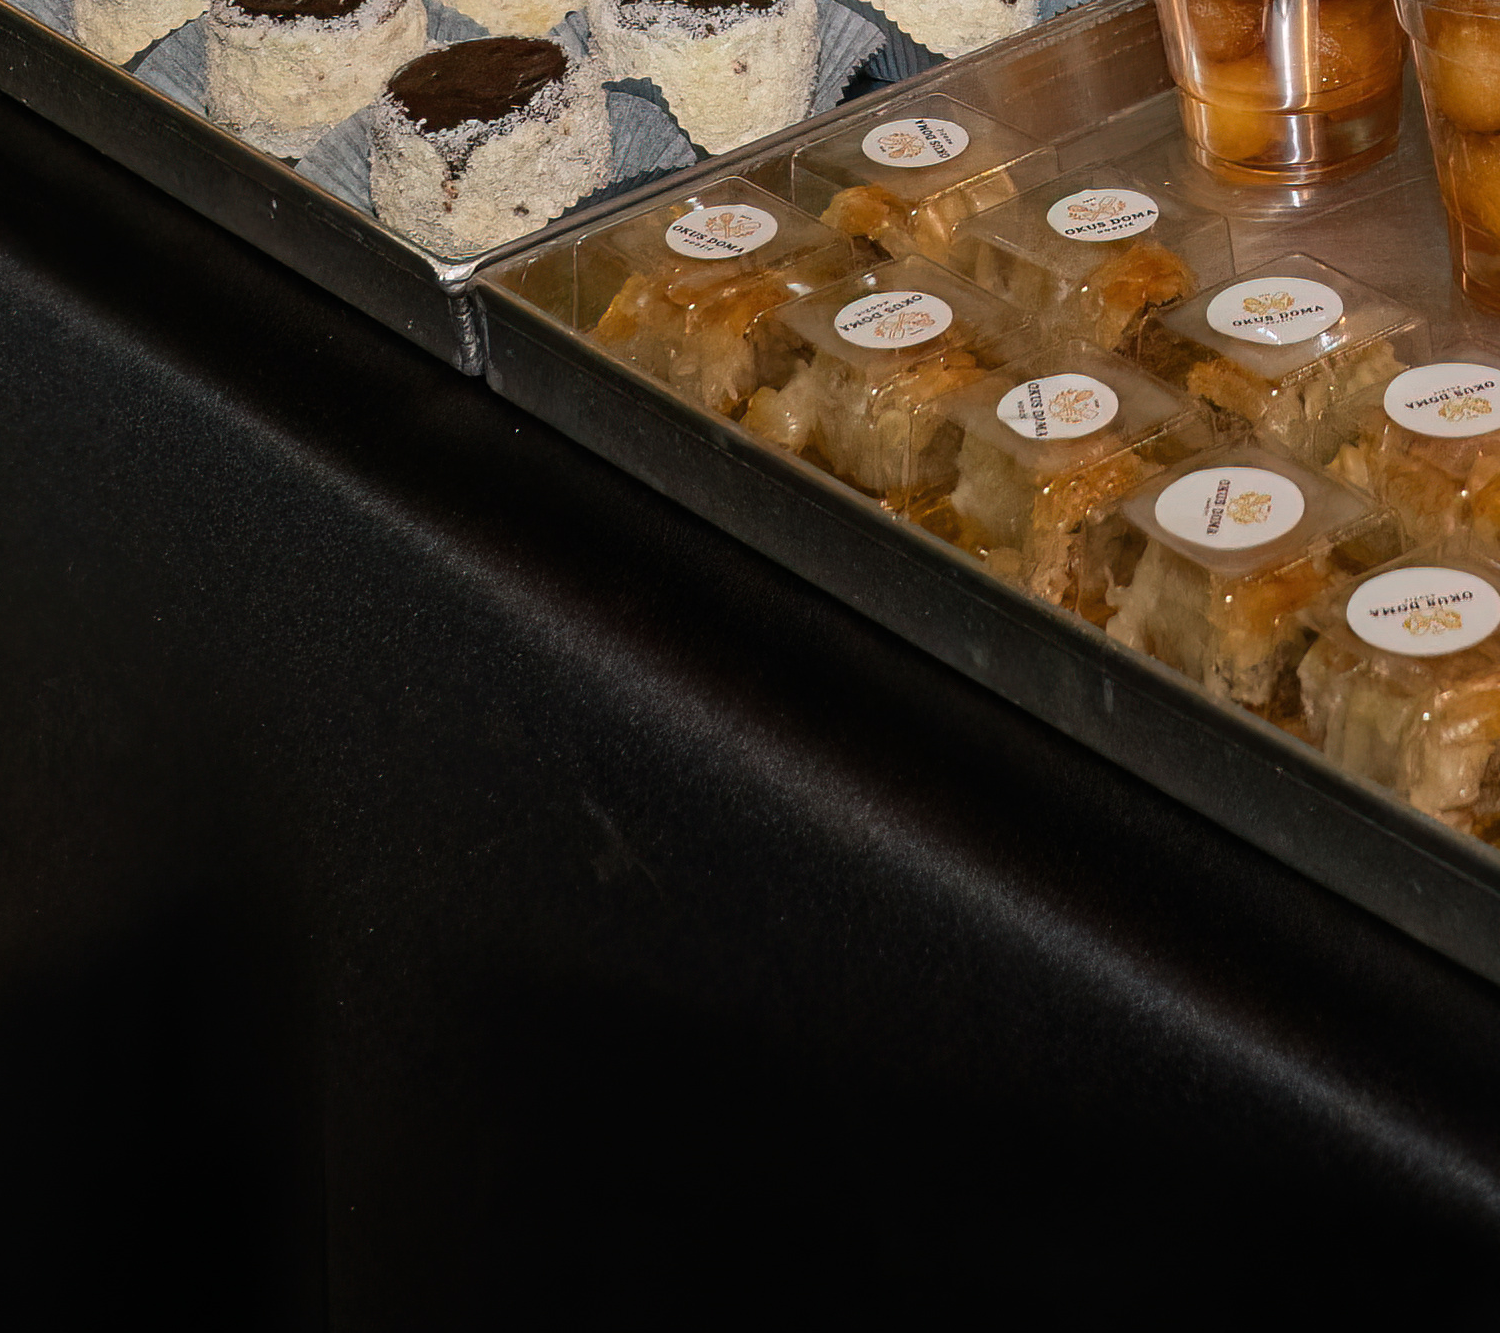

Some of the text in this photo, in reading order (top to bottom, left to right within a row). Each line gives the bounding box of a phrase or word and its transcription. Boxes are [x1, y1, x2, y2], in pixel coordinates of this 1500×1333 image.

[1065, 208, 1158, 236] OKUS DOMA
[672, 224, 746, 254] OKUS DOMA
[1232, 314, 1277, 327] OKUS
[1279, 304, 1325, 321] DOMA
[1453, 379, 1496, 397] OKUS
[1404, 392, 1449, 410] DOMA
